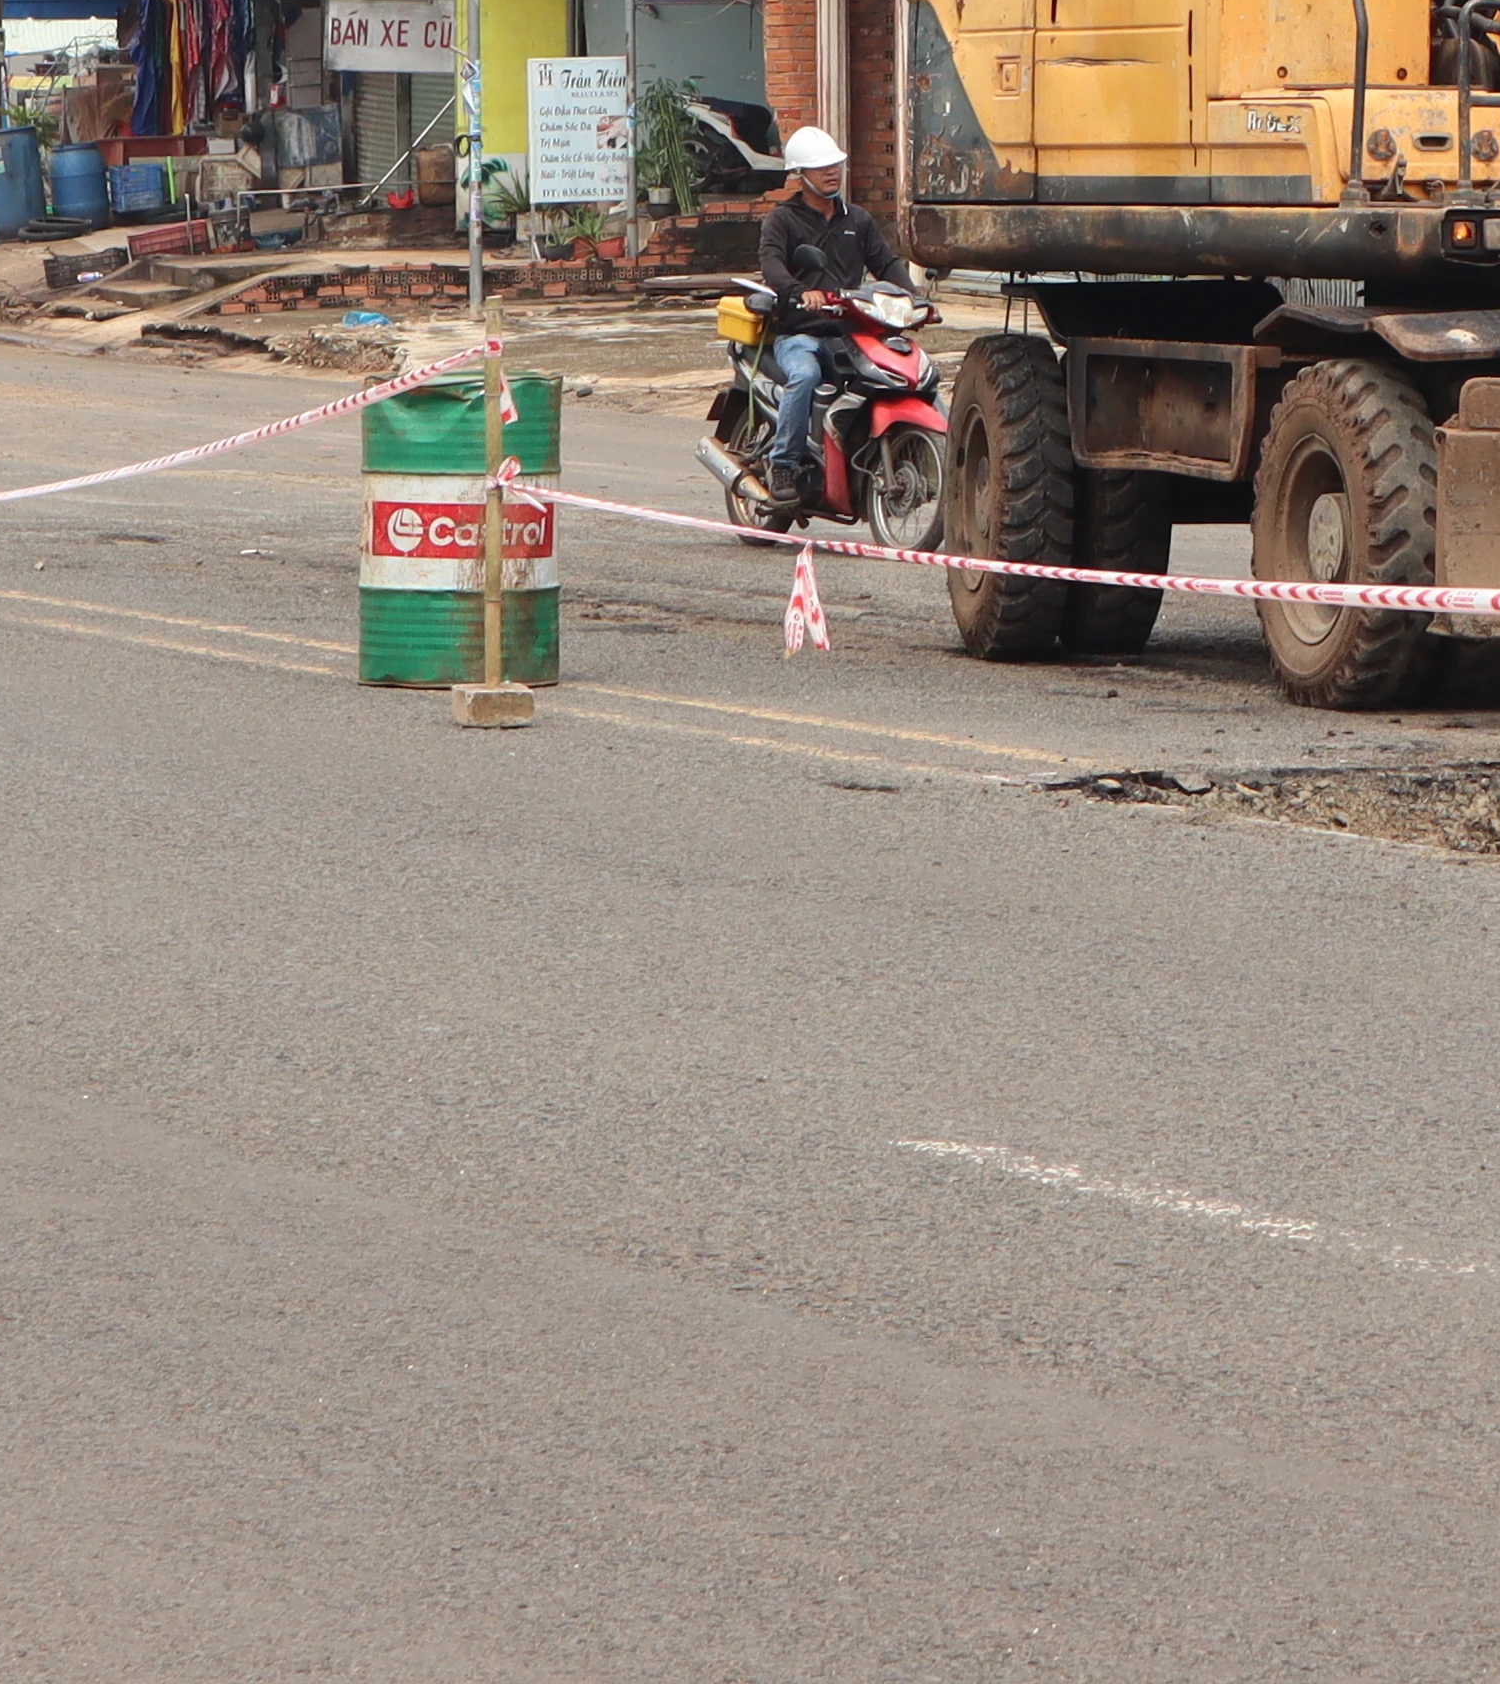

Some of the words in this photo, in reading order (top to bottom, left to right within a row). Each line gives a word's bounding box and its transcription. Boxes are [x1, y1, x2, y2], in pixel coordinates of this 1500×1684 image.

[330, 10, 369, 46] BÁN
[380, 20, 410, 47] XE
[424, 15, 452, 49] CŨ
